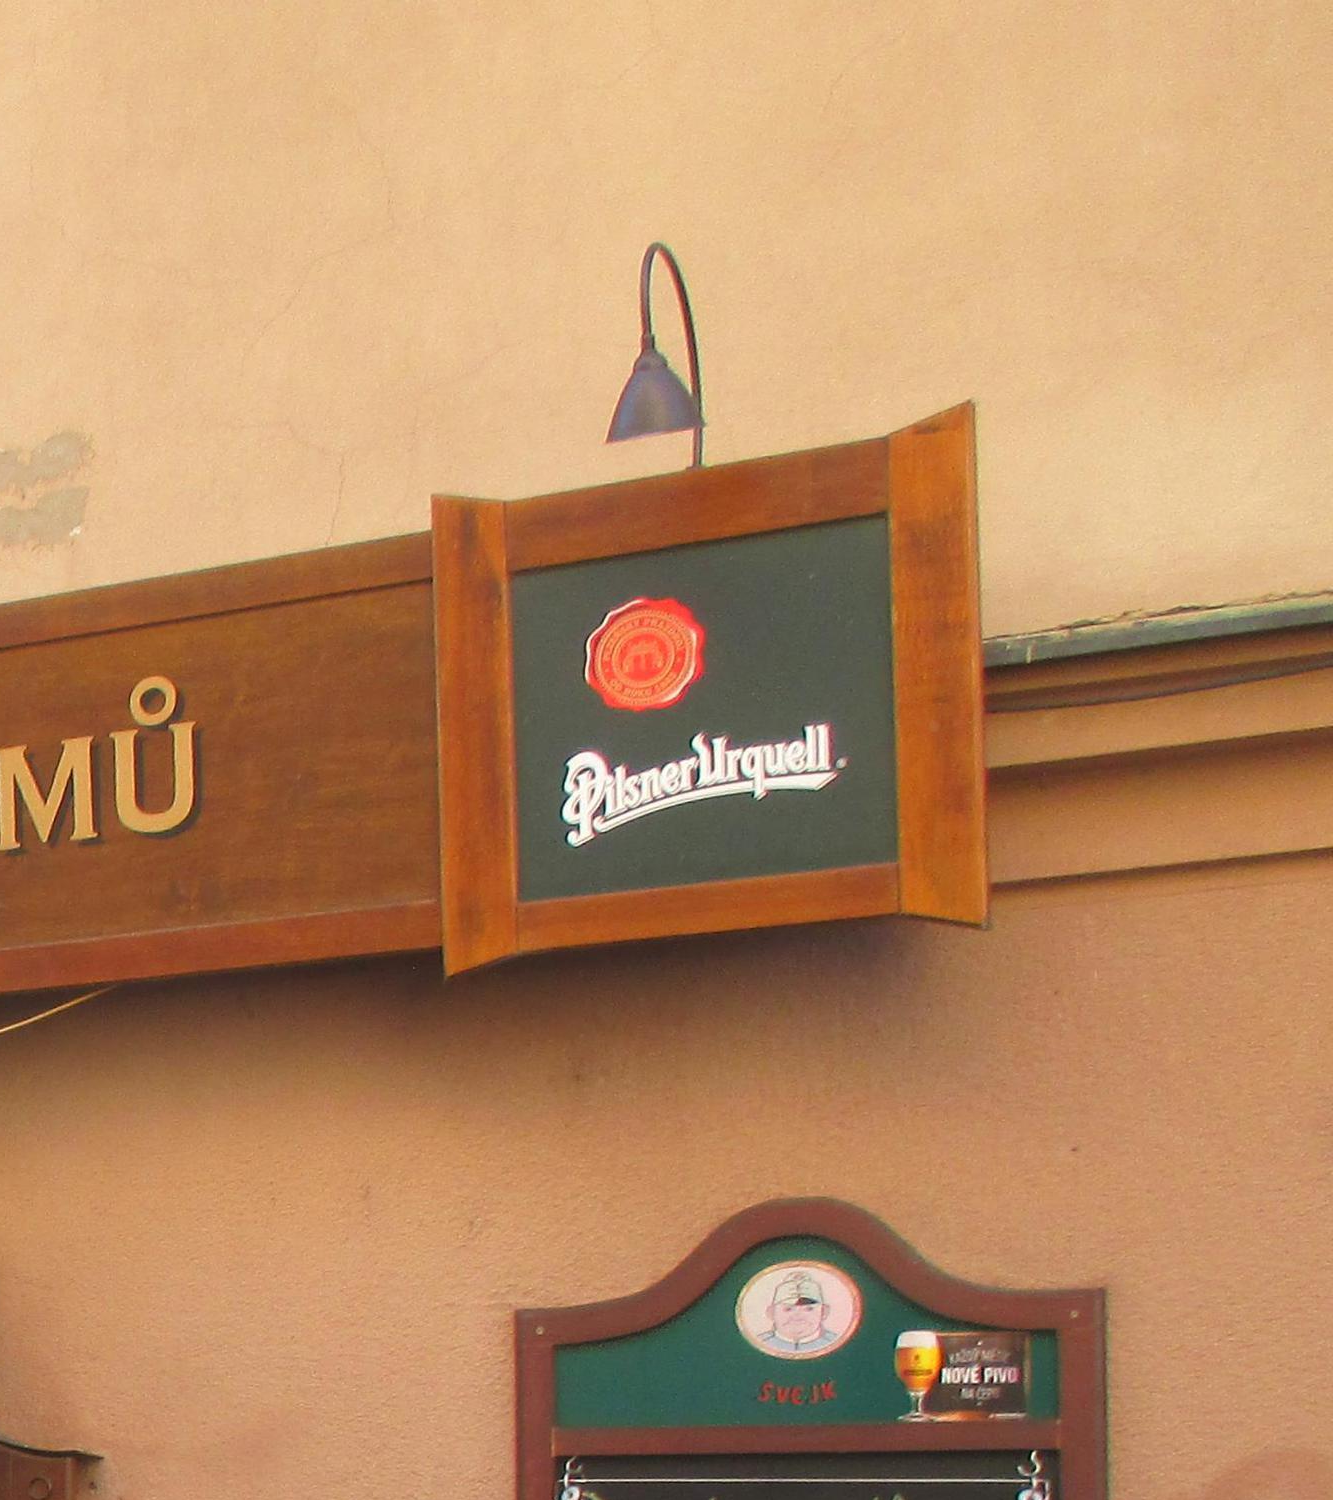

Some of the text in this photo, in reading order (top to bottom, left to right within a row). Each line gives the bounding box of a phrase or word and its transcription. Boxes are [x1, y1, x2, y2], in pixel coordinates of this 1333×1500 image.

[562, 721, 832, 847] Pilsner Urquell
[941, 1364, 1020, 1384] NOVÉ PIVO
